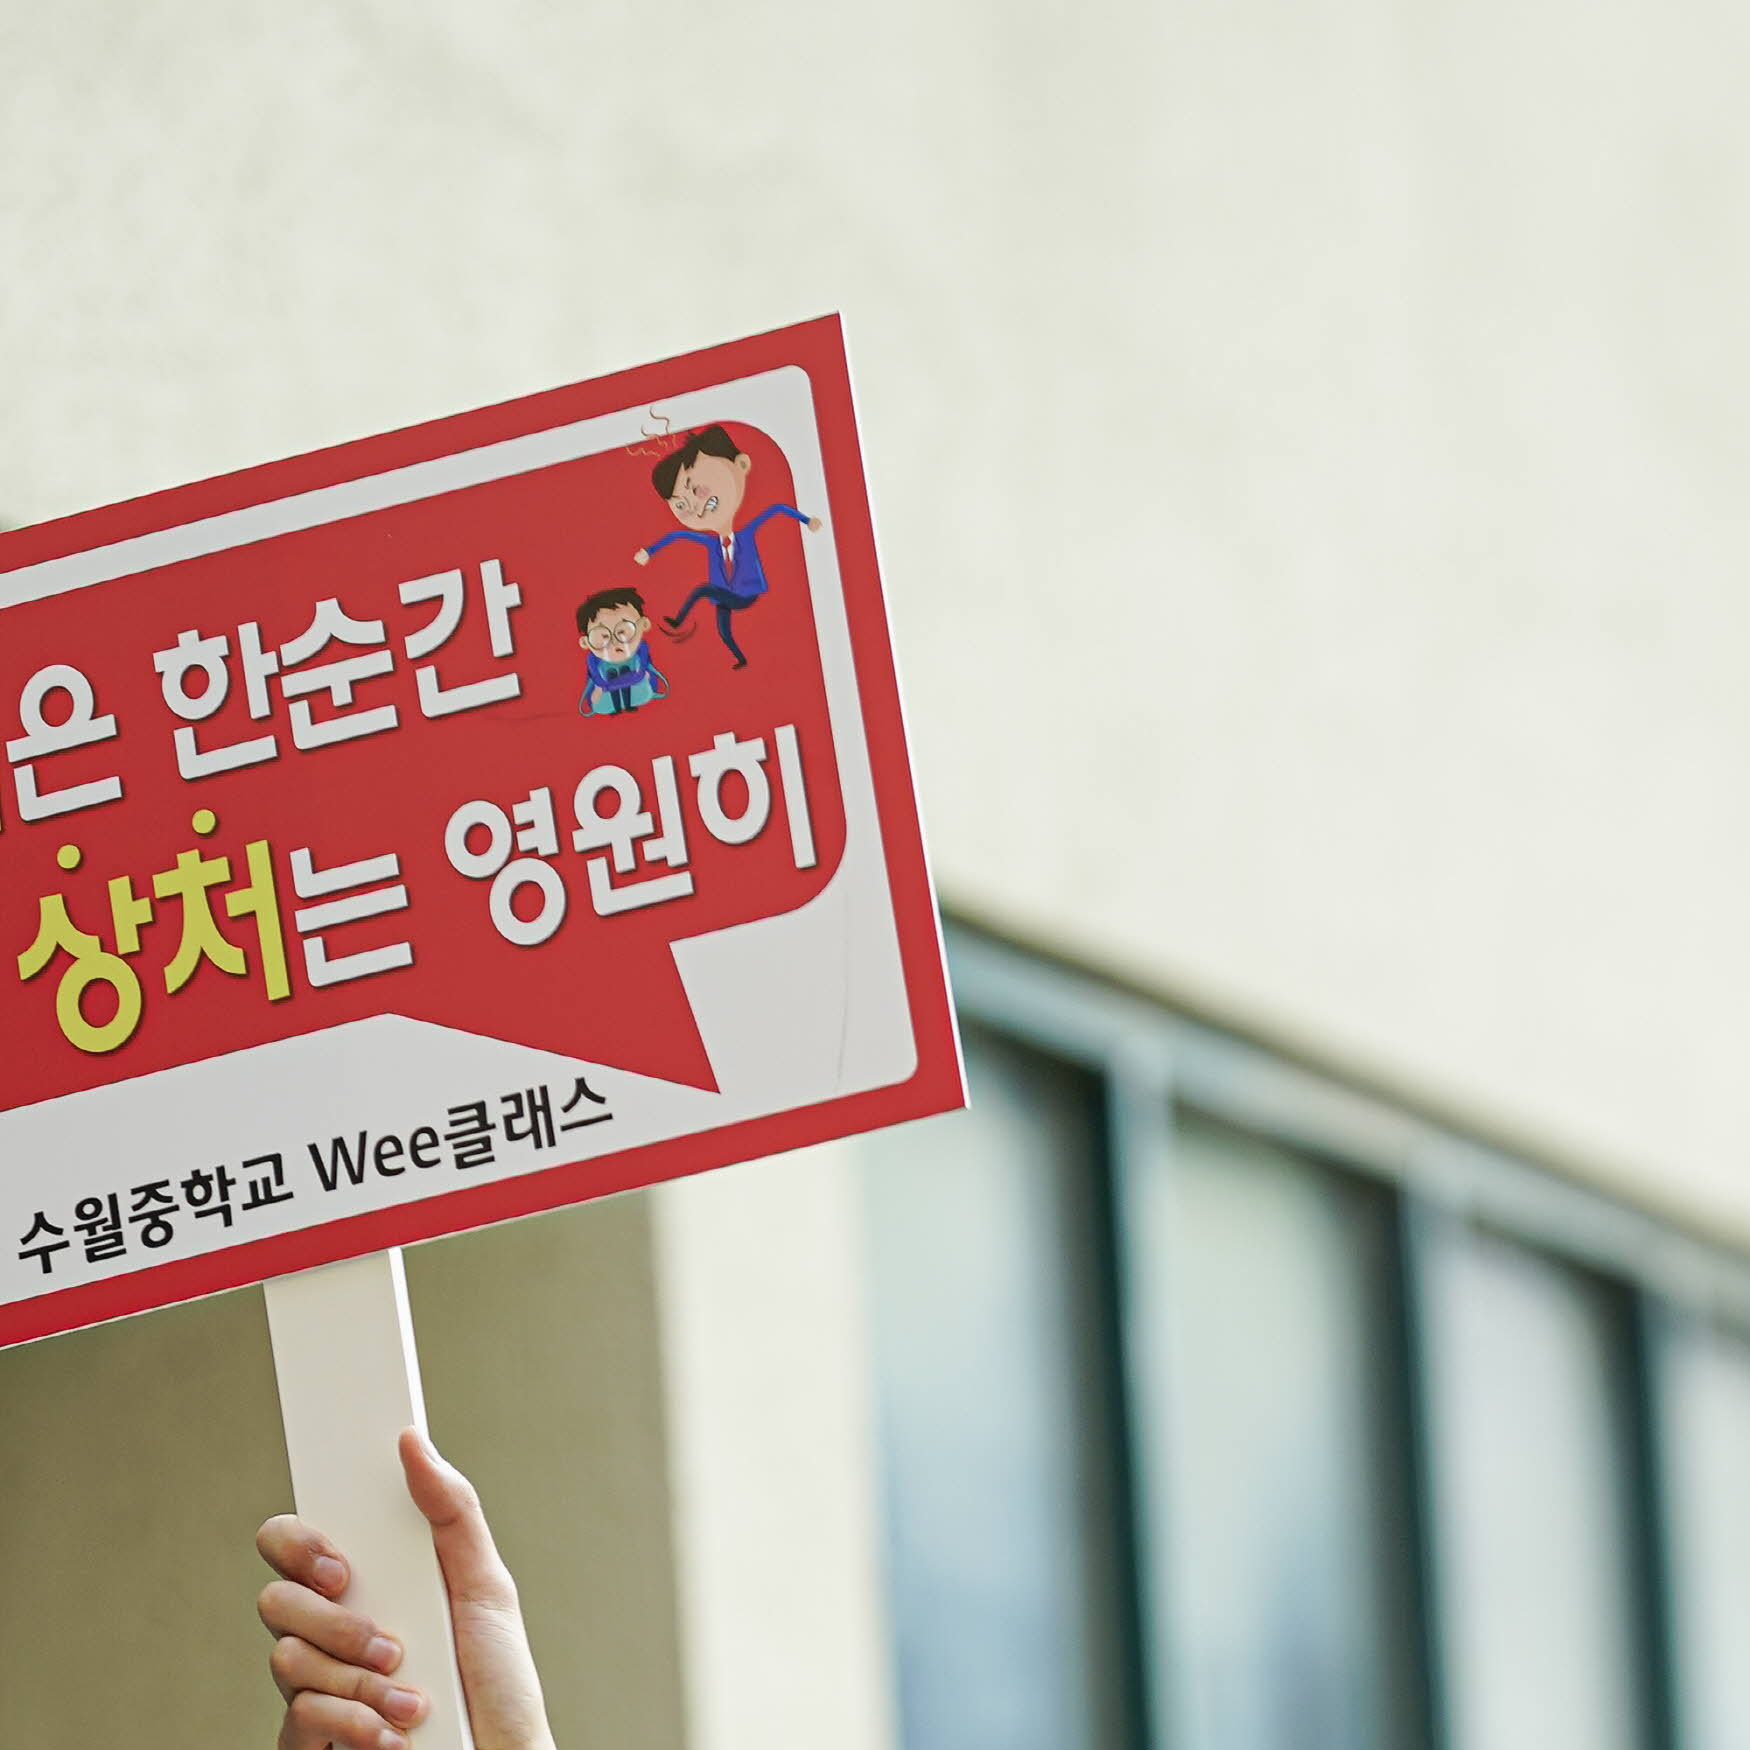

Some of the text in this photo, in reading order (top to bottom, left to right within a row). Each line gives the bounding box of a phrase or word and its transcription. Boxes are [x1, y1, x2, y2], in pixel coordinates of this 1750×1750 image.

[0, 558, 523, 830] 은 한순간
[17, 724, 817, 1054] 상처는 영원히
[17, 1075, 614, 1275] 수월중학교 Wee클래스
